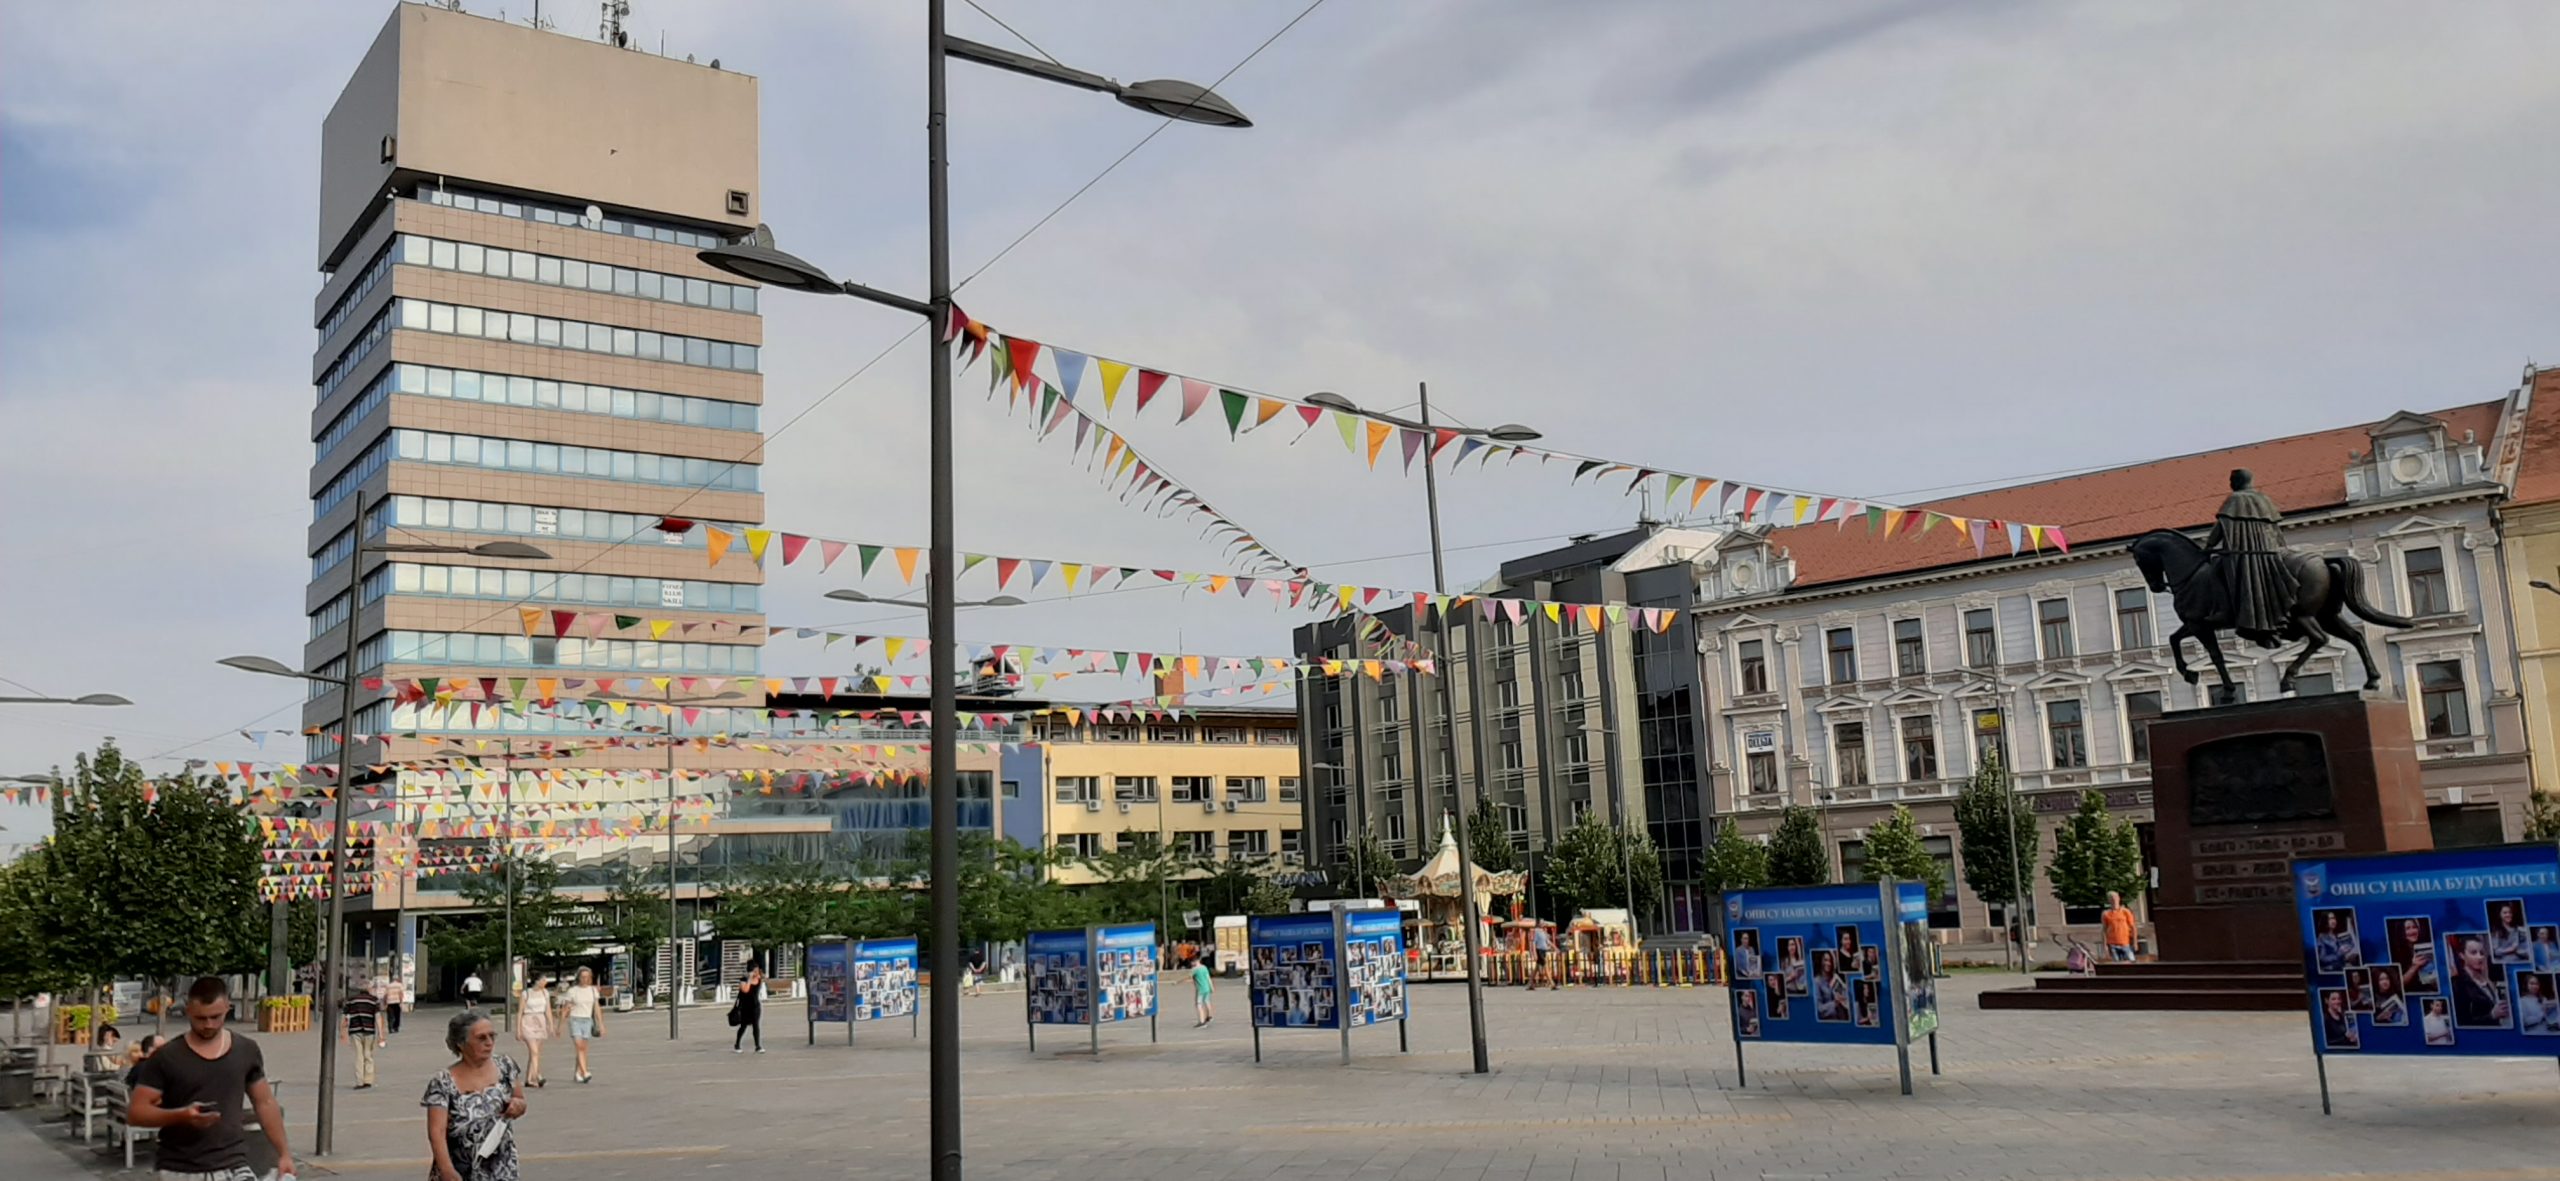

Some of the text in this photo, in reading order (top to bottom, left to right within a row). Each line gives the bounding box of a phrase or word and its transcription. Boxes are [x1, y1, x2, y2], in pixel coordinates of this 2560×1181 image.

[2330, 882, 2366, 897] ОНИ
[2368, 880, 2388, 895] СУ
[2392, 878, 2442, 893] НАША
[2445, 873, 2548, 891] БУДУЋНОСТ
